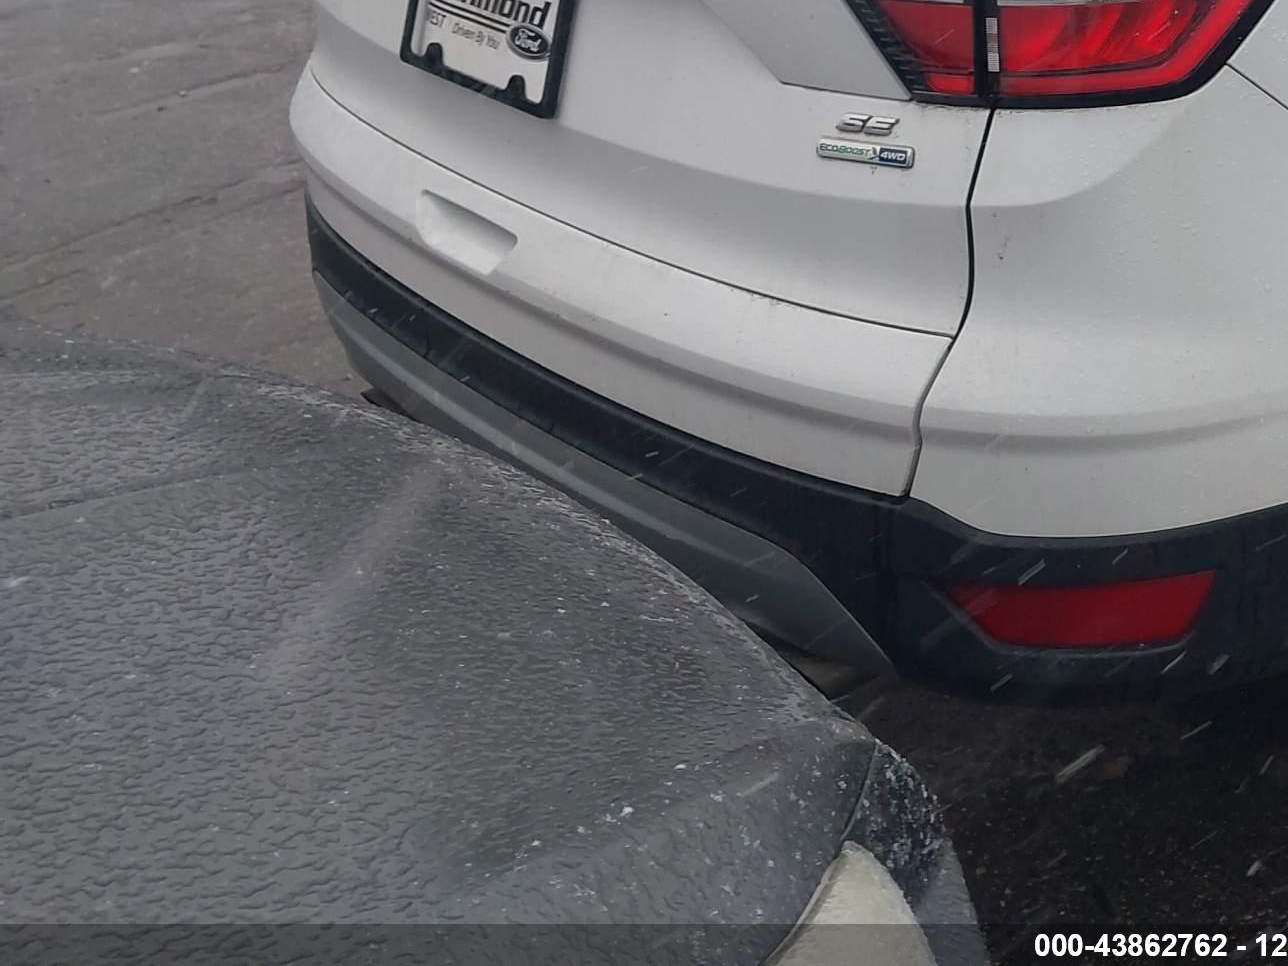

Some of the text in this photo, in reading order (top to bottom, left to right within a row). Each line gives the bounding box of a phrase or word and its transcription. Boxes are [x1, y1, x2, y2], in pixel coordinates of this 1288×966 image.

[515, 28, 542, 52] Ford
[836, 112, 901, 137] SE
[880, 150, 906, 161] 4WD
